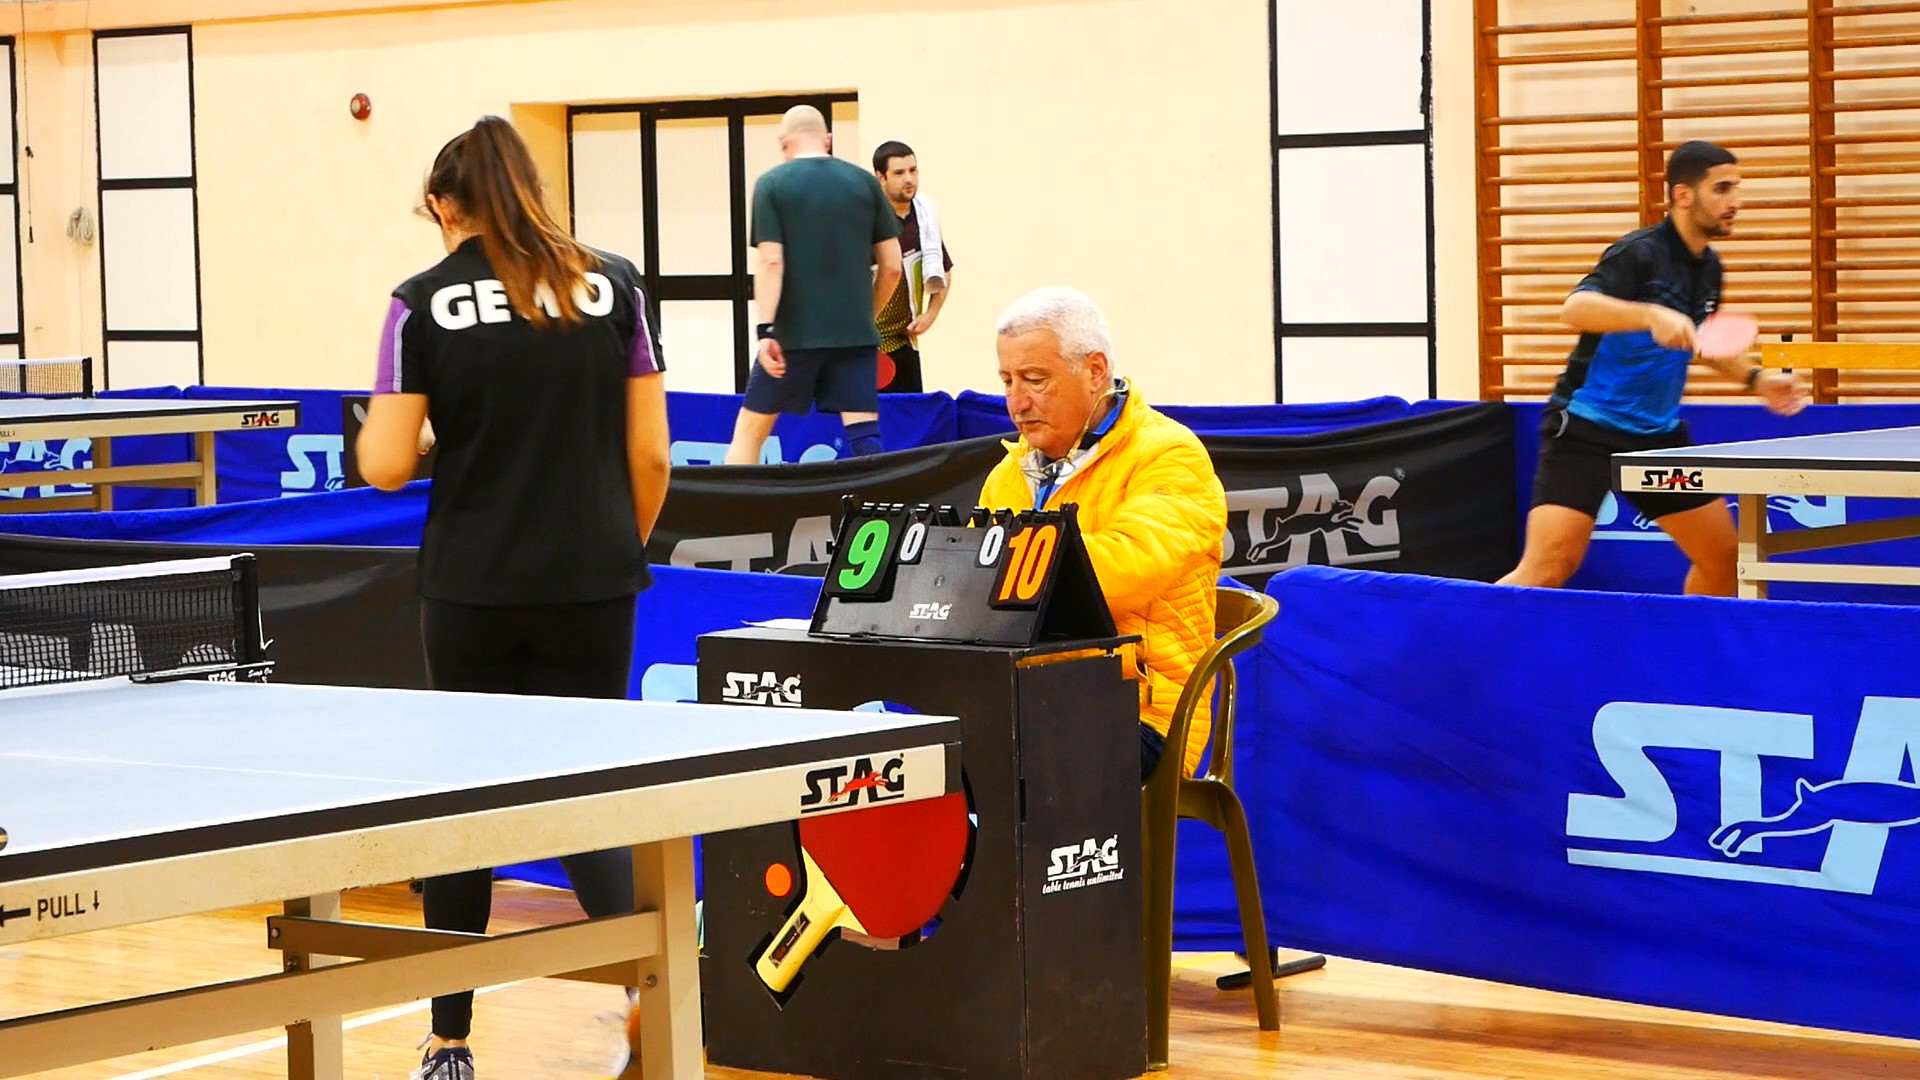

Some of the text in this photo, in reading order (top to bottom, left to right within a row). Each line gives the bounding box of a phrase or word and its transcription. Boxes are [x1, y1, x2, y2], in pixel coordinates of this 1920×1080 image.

[241, 412, 280, 427] STAG
[0, 437, 93, 498] AG
[1641, 468, 1703, 490] STAG
[1223, 472, 1401, 566] TAG
[838, 519, 890, 590] 9
[900, 522, 926, 562] 0
[979, 525, 1005, 566] 0
[998, 524, 1058, 600] 10
[909, 602, 951, 620] STAG
[722, 671, 802, 706] STAG
[800, 756, 905, 813] STAG
[1047, 837, 1119, 881] STAG
[1042, 867, 1124, 895] table tennis unlimited
[36, 892, 86, 922] PULL
